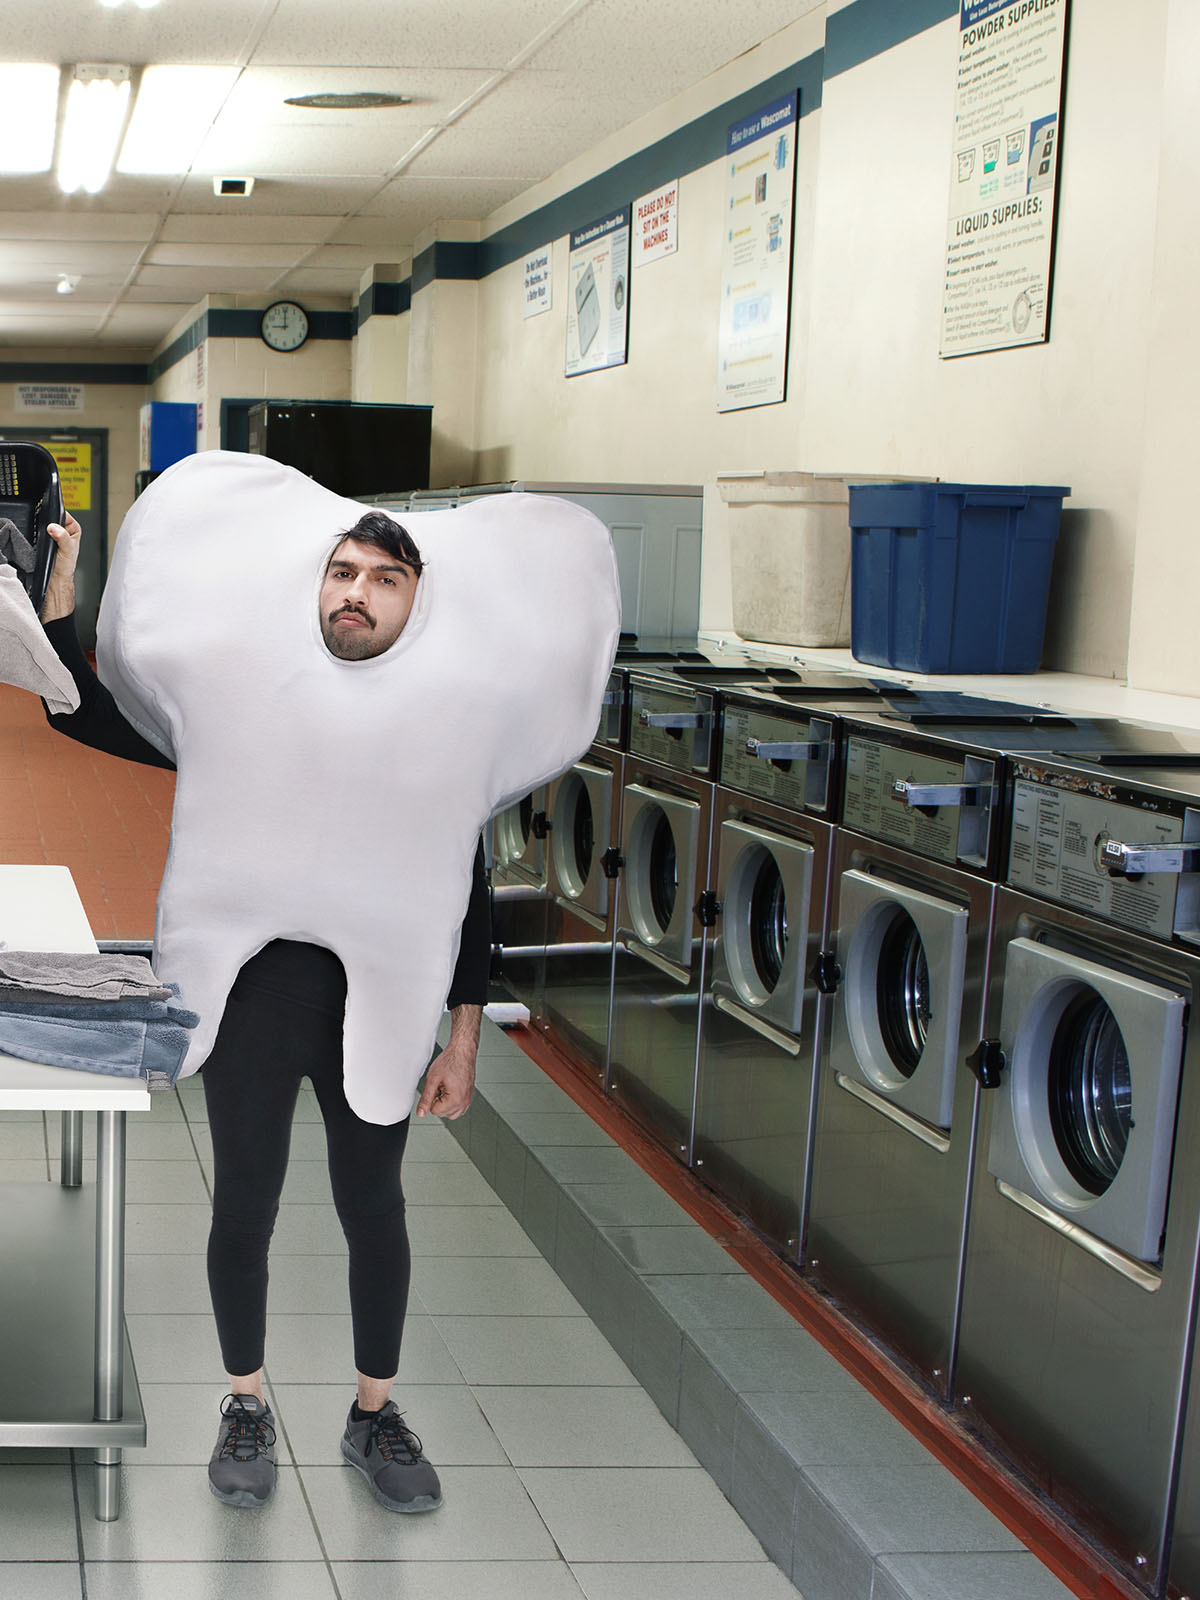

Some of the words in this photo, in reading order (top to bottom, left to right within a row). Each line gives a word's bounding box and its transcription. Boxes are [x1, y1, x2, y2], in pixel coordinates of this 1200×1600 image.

[963, 15, 1004, 48] POWDER
[760, 104, 791, 129] Wascomat
[638, 199, 656, 220] PLEASE
[656, 196, 664, 210] DO
[664, 190, 676, 207] NOT
[956, 212, 989, 236] LIQUID
[992, 196, 1042, 226] SUPPLIES:
[643, 219, 651, 234] SIT
[651, 215, 659, 230] ON
[659, 212, 669, 227] THE
[643, 228, 668, 252] MACHINES
